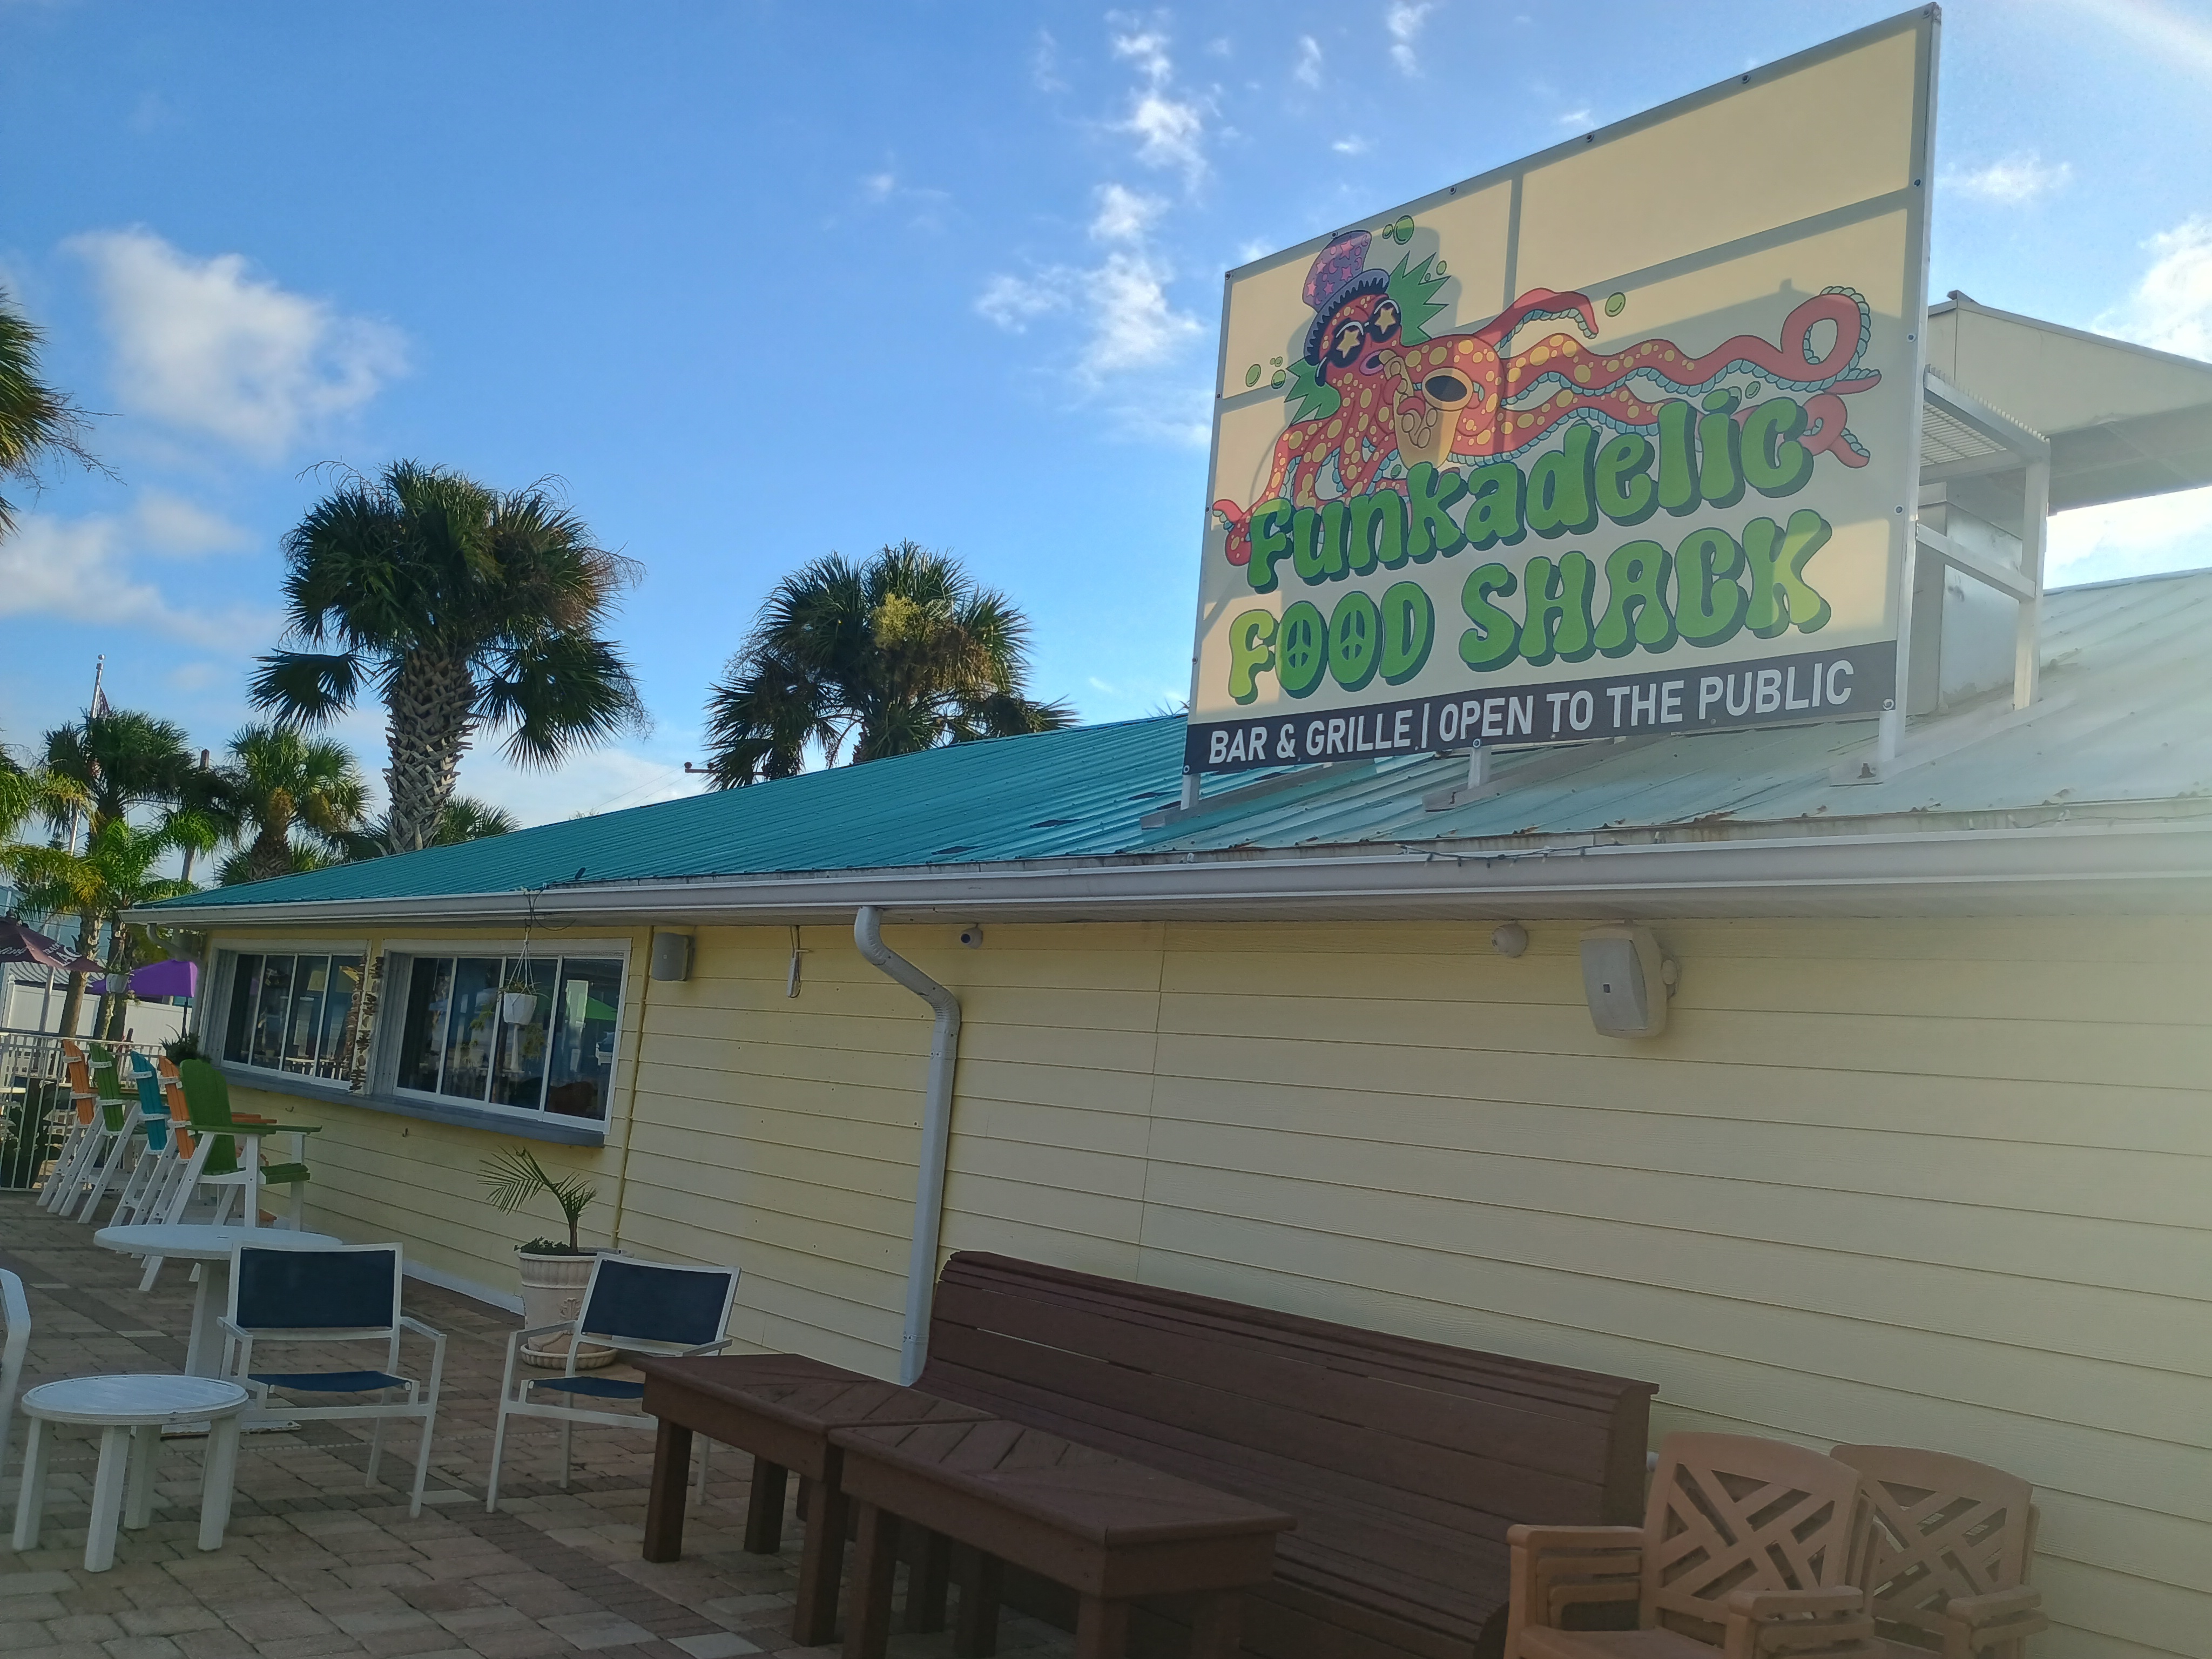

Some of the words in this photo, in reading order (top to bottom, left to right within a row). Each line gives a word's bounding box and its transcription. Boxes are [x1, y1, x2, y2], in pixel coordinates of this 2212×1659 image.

[1228, 582, 1435, 705] FOOD
[1459, 509, 1832, 672] SHACK
[1209, 727, 1267, 764] BAR
[1277, 724, 1296, 757] &
[1306, 711, 1413, 754] GRILLE
[1440, 696, 1533, 742] OPEN
[1546, 691, 1593, 732] TO
[1607, 680, 1684, 727] THE
[1699, 660, 1854, 719] PUBLIC
